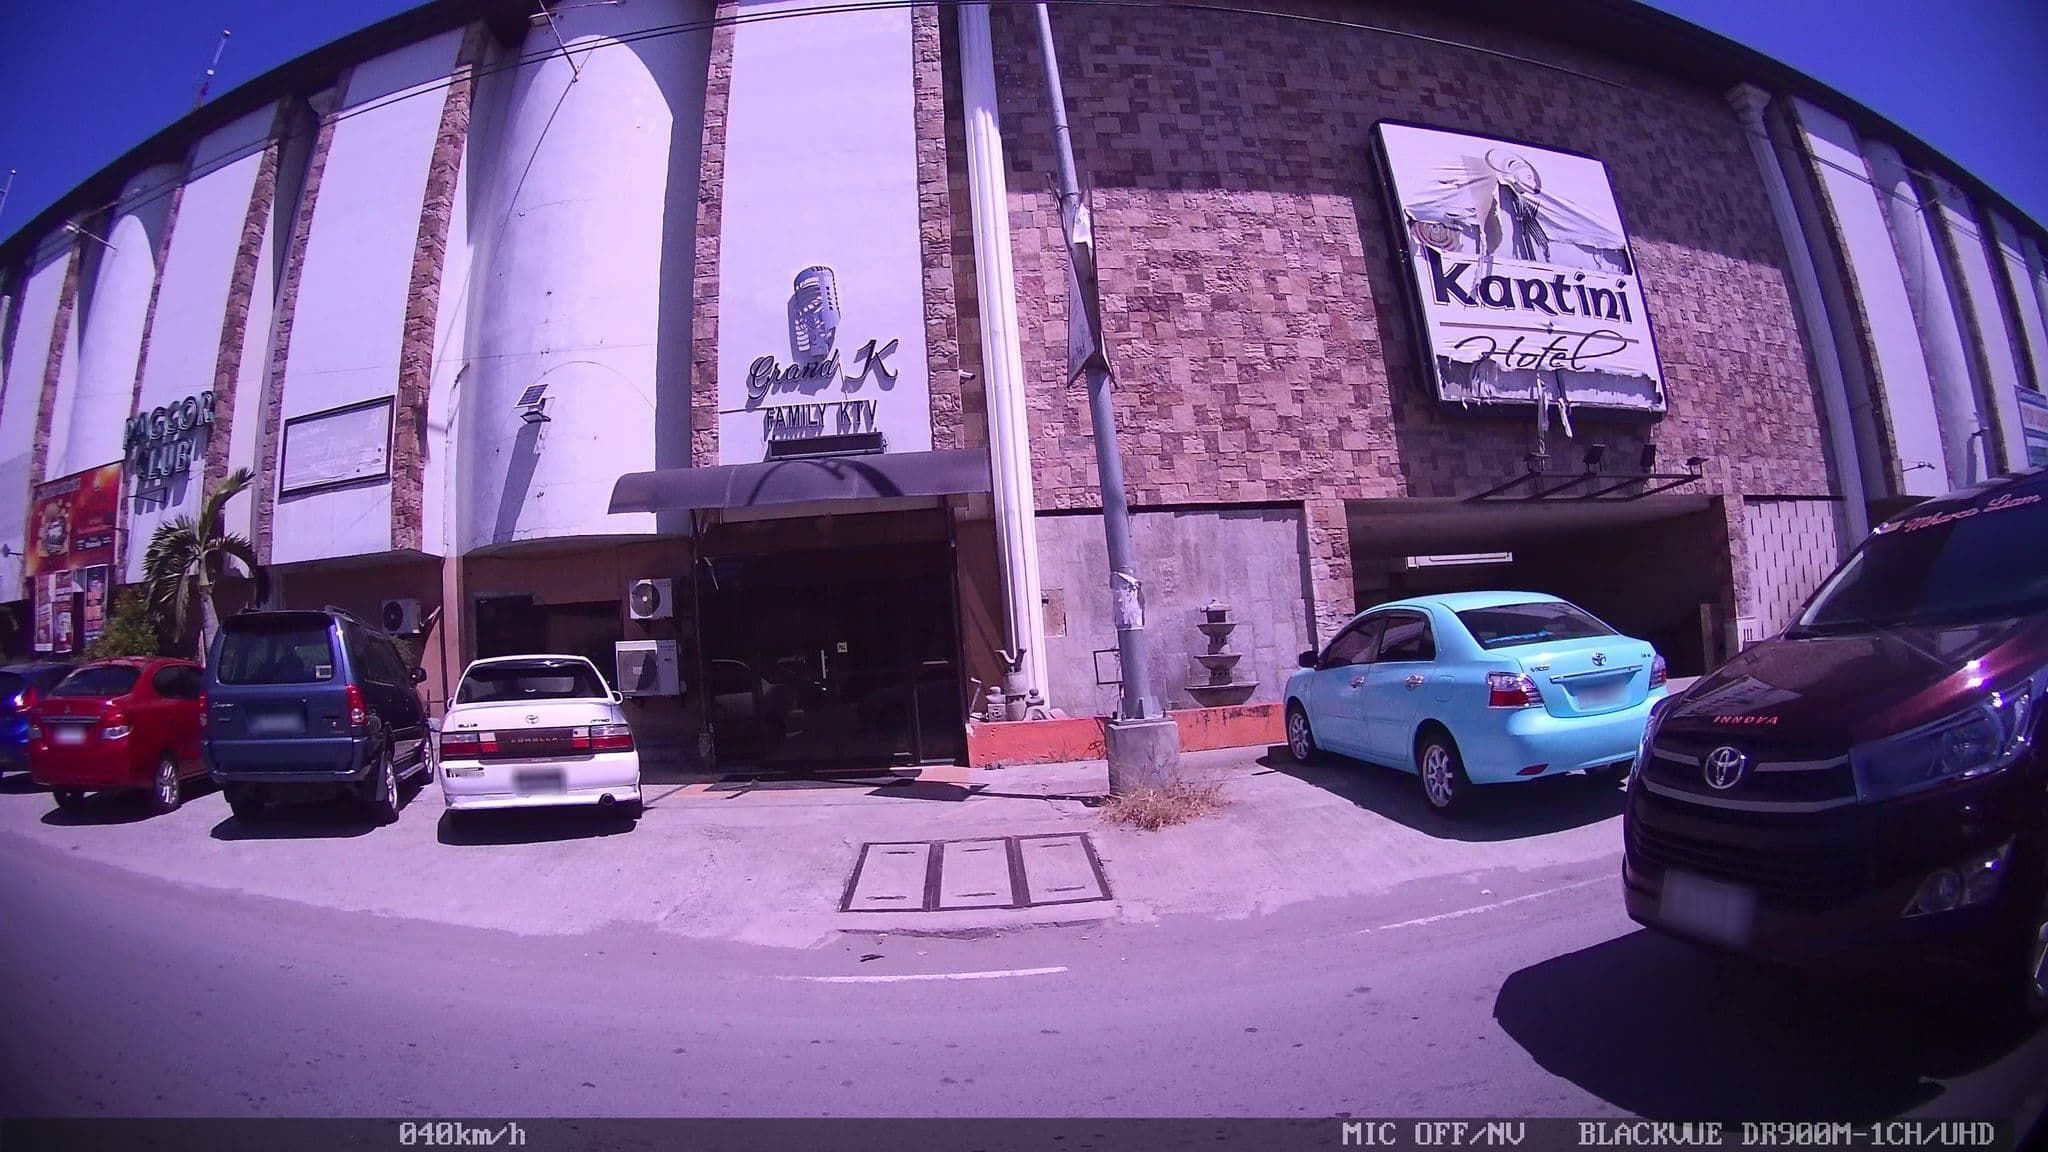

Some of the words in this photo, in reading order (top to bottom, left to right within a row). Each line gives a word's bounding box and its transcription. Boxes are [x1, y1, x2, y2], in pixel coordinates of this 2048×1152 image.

[748, 348, 840, 400] Grand
[845, 338, 899, 379] K
[1454, 329, 1628, 371] Hotel
[766, 402, 827, 431] FAMILY
[840, 399, 878, 426] KTV
[136, 439, 192, 480] CLUB
[1713, 715, 1779, 725] INNOVA
